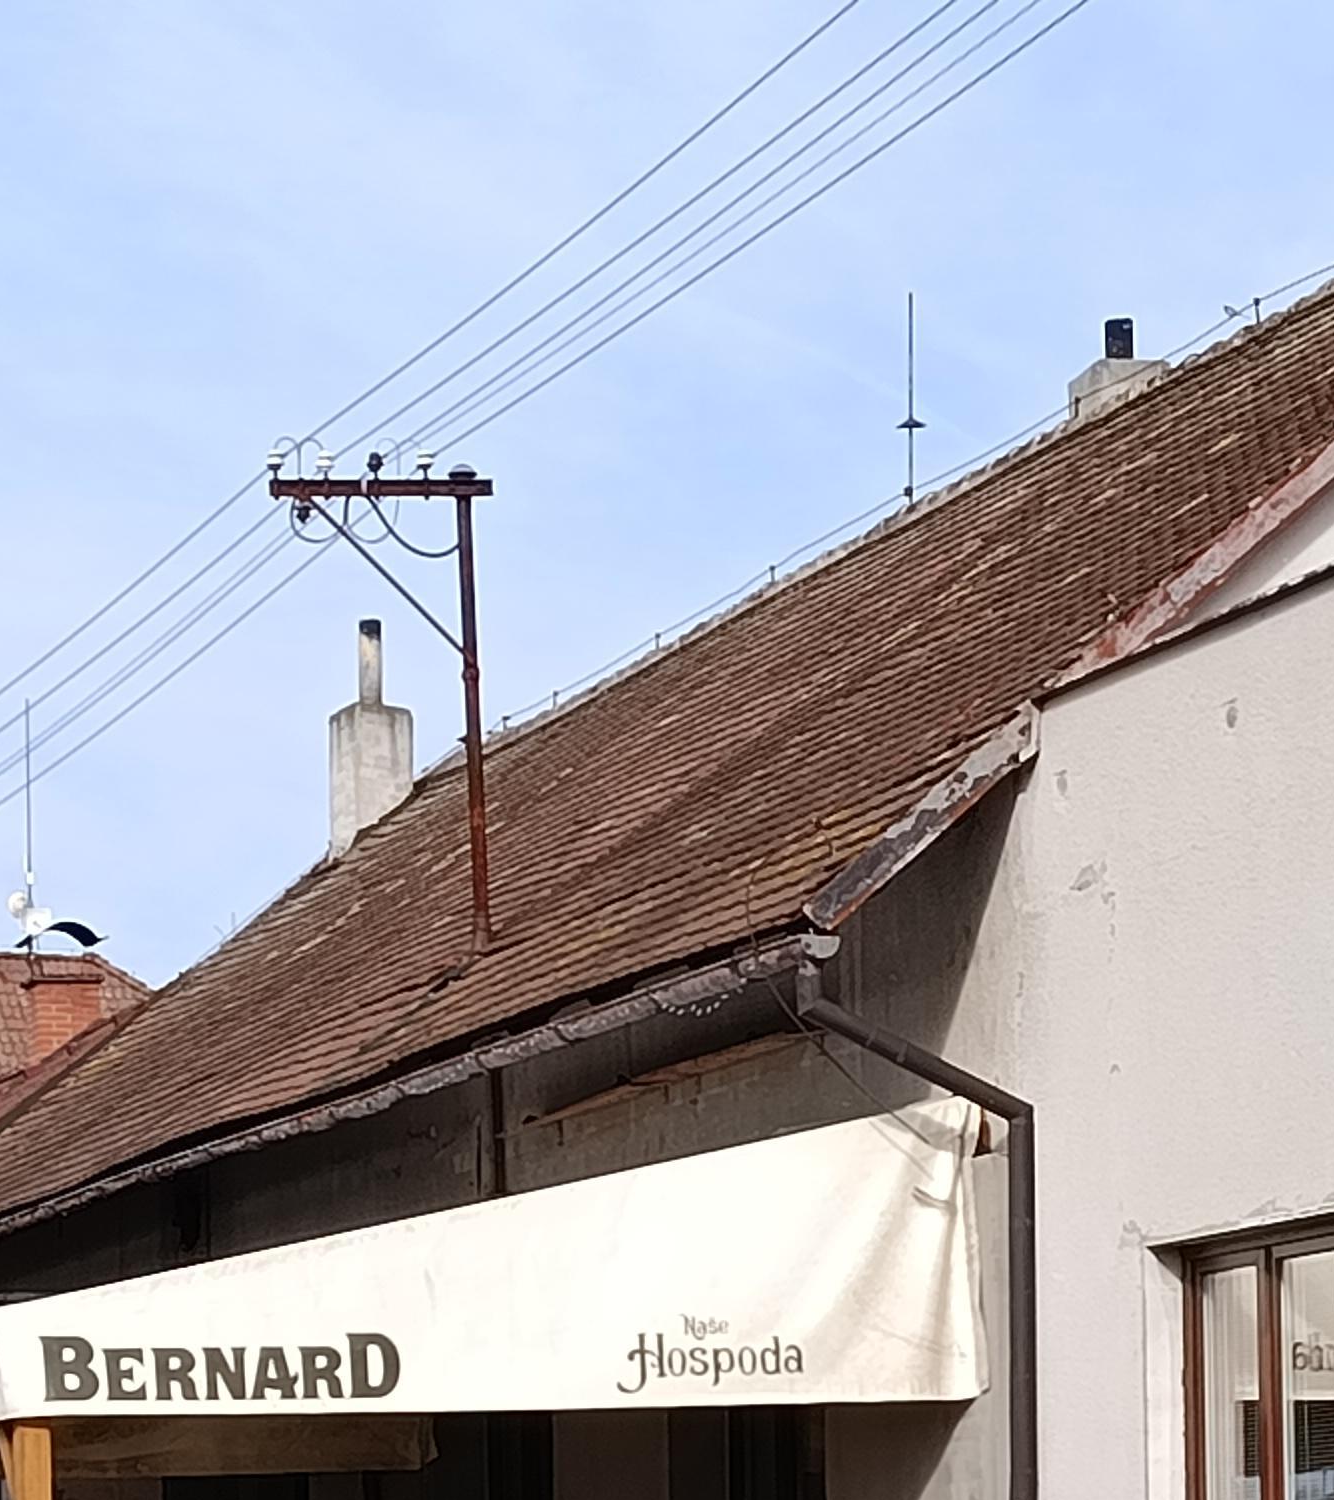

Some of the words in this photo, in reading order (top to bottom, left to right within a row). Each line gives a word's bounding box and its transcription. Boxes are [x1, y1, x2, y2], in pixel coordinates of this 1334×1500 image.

[680, 1313, 729, 1341] Naše
[38, 1332, 401, 1402] BERNARD
[617, 1333, 803, 1394] Hospoda
